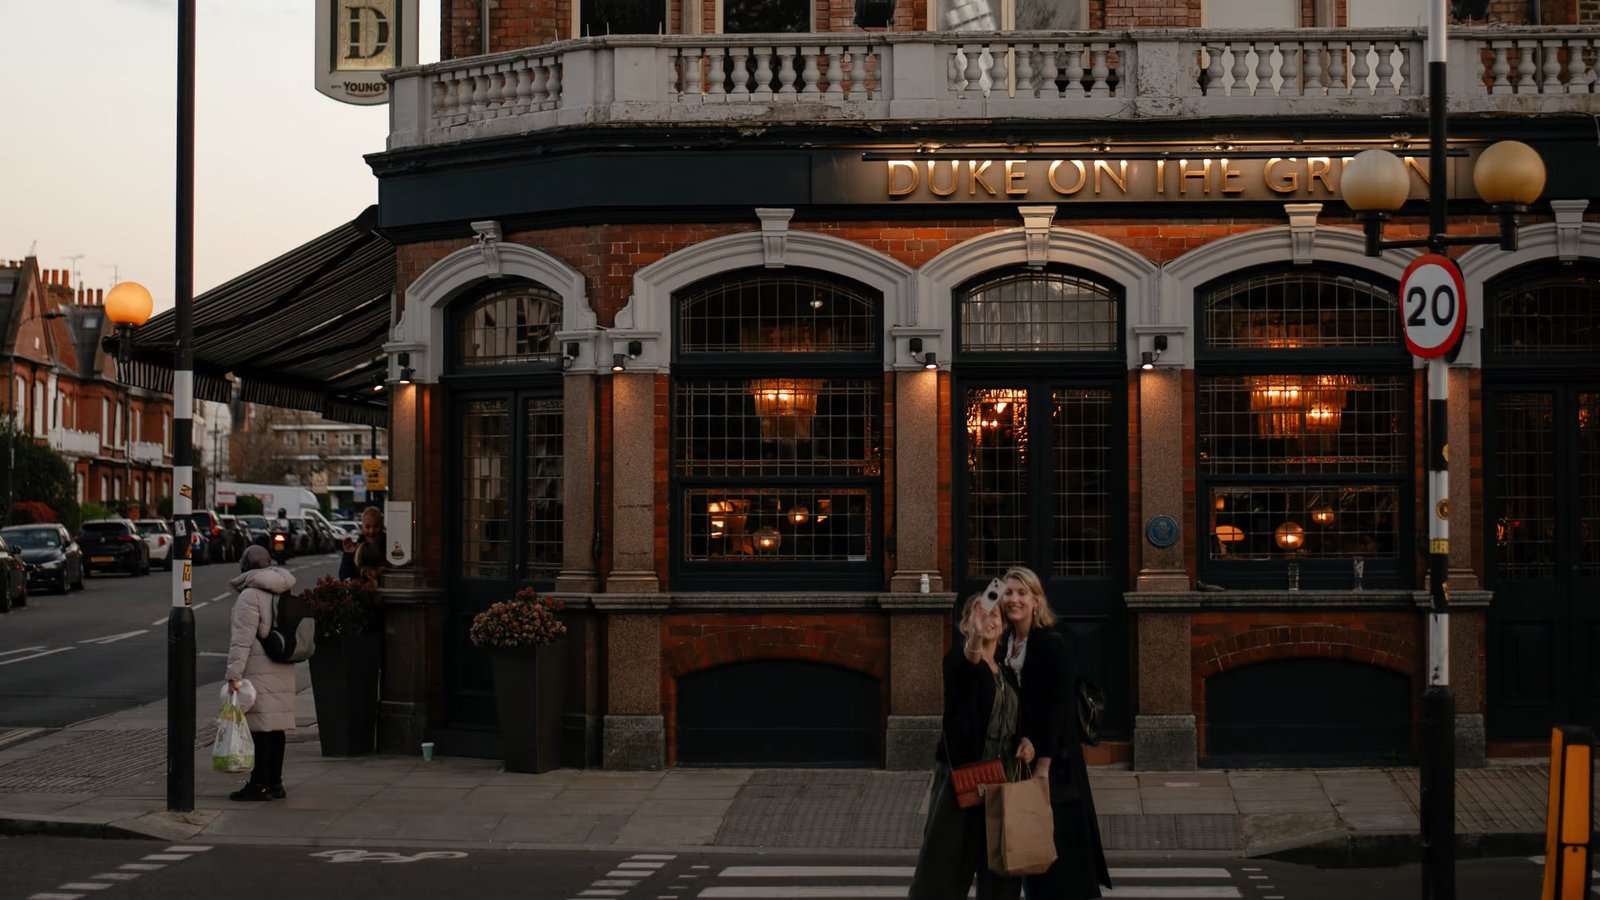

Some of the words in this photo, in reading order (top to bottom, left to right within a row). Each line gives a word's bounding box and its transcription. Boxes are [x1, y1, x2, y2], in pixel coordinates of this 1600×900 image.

[344, 6, 389, 59] D
[343, 82, 387, 92] YOUNG'S
[888, 160, 1030, 196] DUKE
[1048, 160, 1128, 195] ON
[1406, 284, 1455, 327] 20
